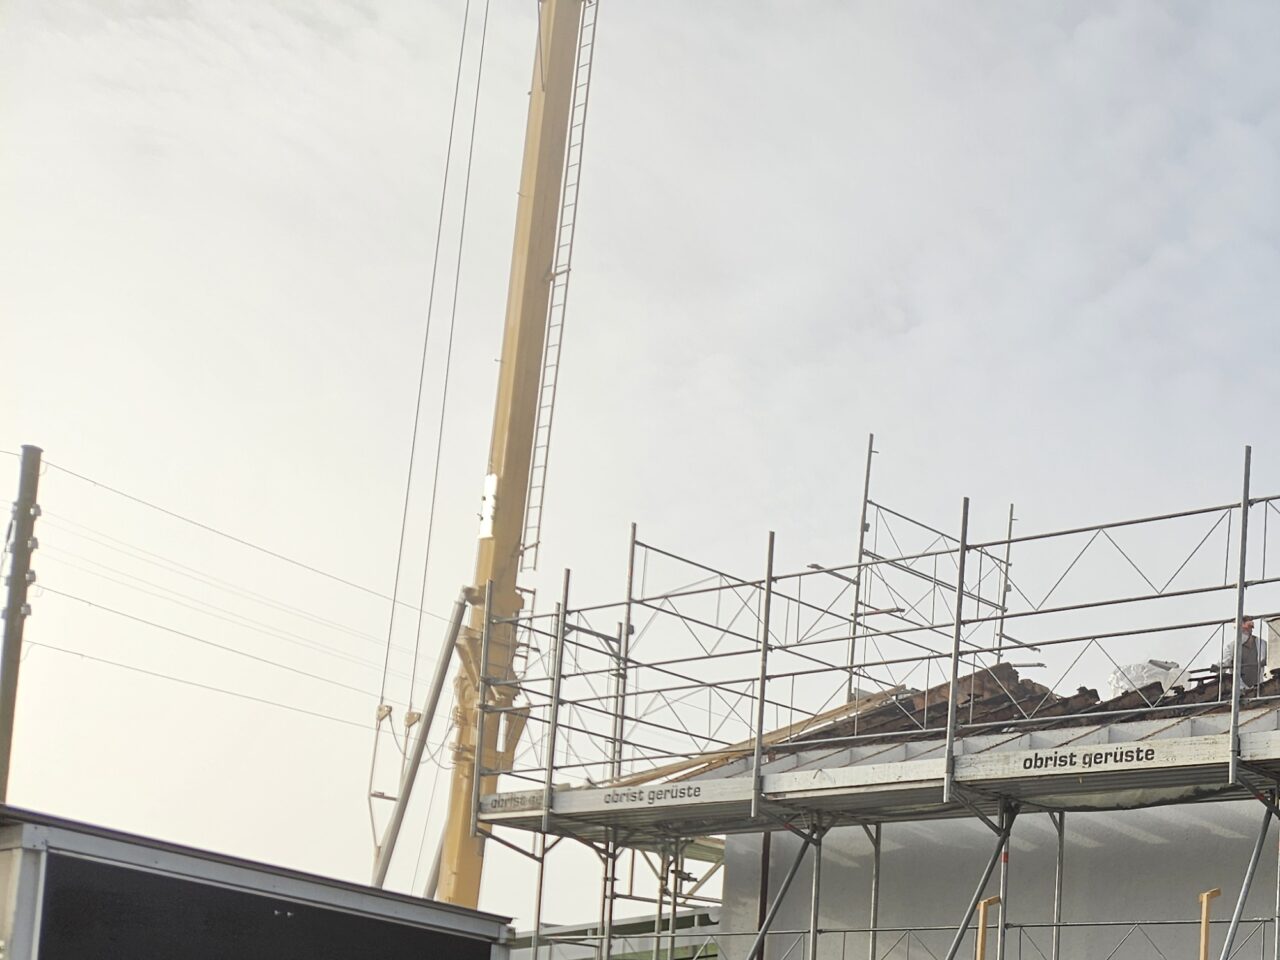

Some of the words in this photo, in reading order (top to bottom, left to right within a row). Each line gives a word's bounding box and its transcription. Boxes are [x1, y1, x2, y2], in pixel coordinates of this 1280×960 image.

[1023, 750, 1077, 770] obrist
[1082, 746, 1155, 768] gerüste
[604, 787, 645, 804] obrist
[648, 785, 701, 805] gerüste
